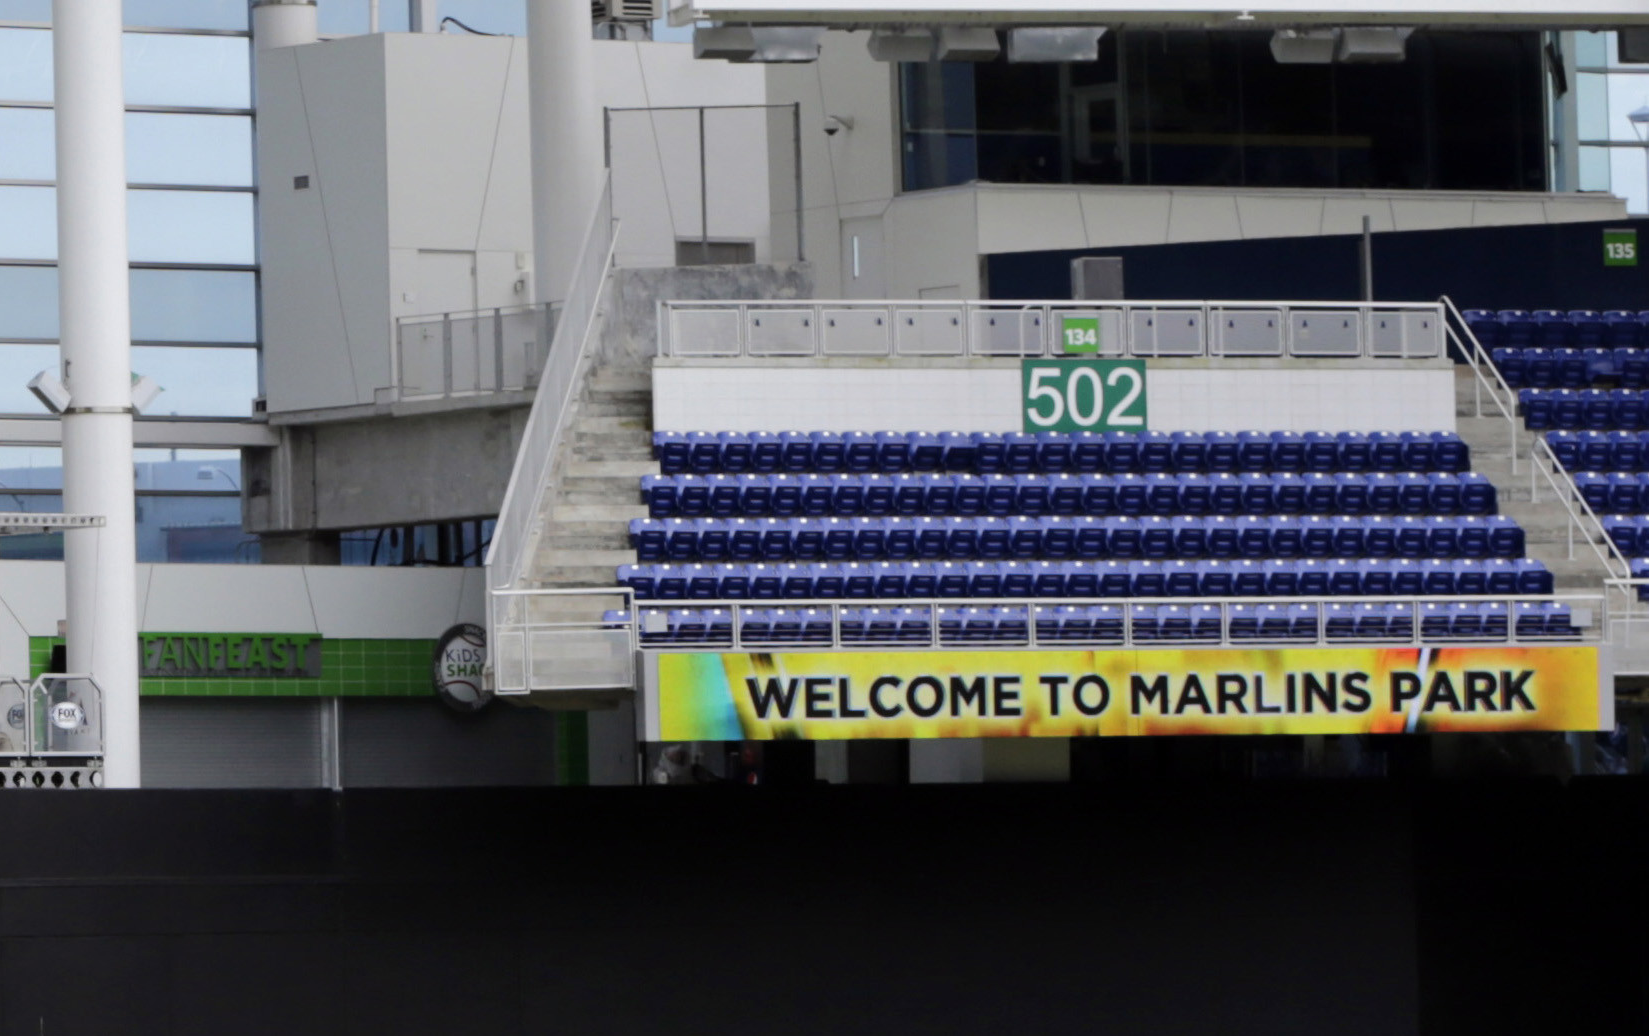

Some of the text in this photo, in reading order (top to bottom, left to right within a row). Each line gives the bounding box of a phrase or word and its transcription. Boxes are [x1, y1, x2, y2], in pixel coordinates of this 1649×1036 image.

[1606, 243, 1635, 259] 135
[1064, 328, 1097, 346] 134
[1027, 366, 1144, 427] 502
[141, 637, 310, 670] FANFEAST
[744, 669, 1537, 720] WELCOME TO MARLINS PARK
[58, 708, 77, 718] FOX
